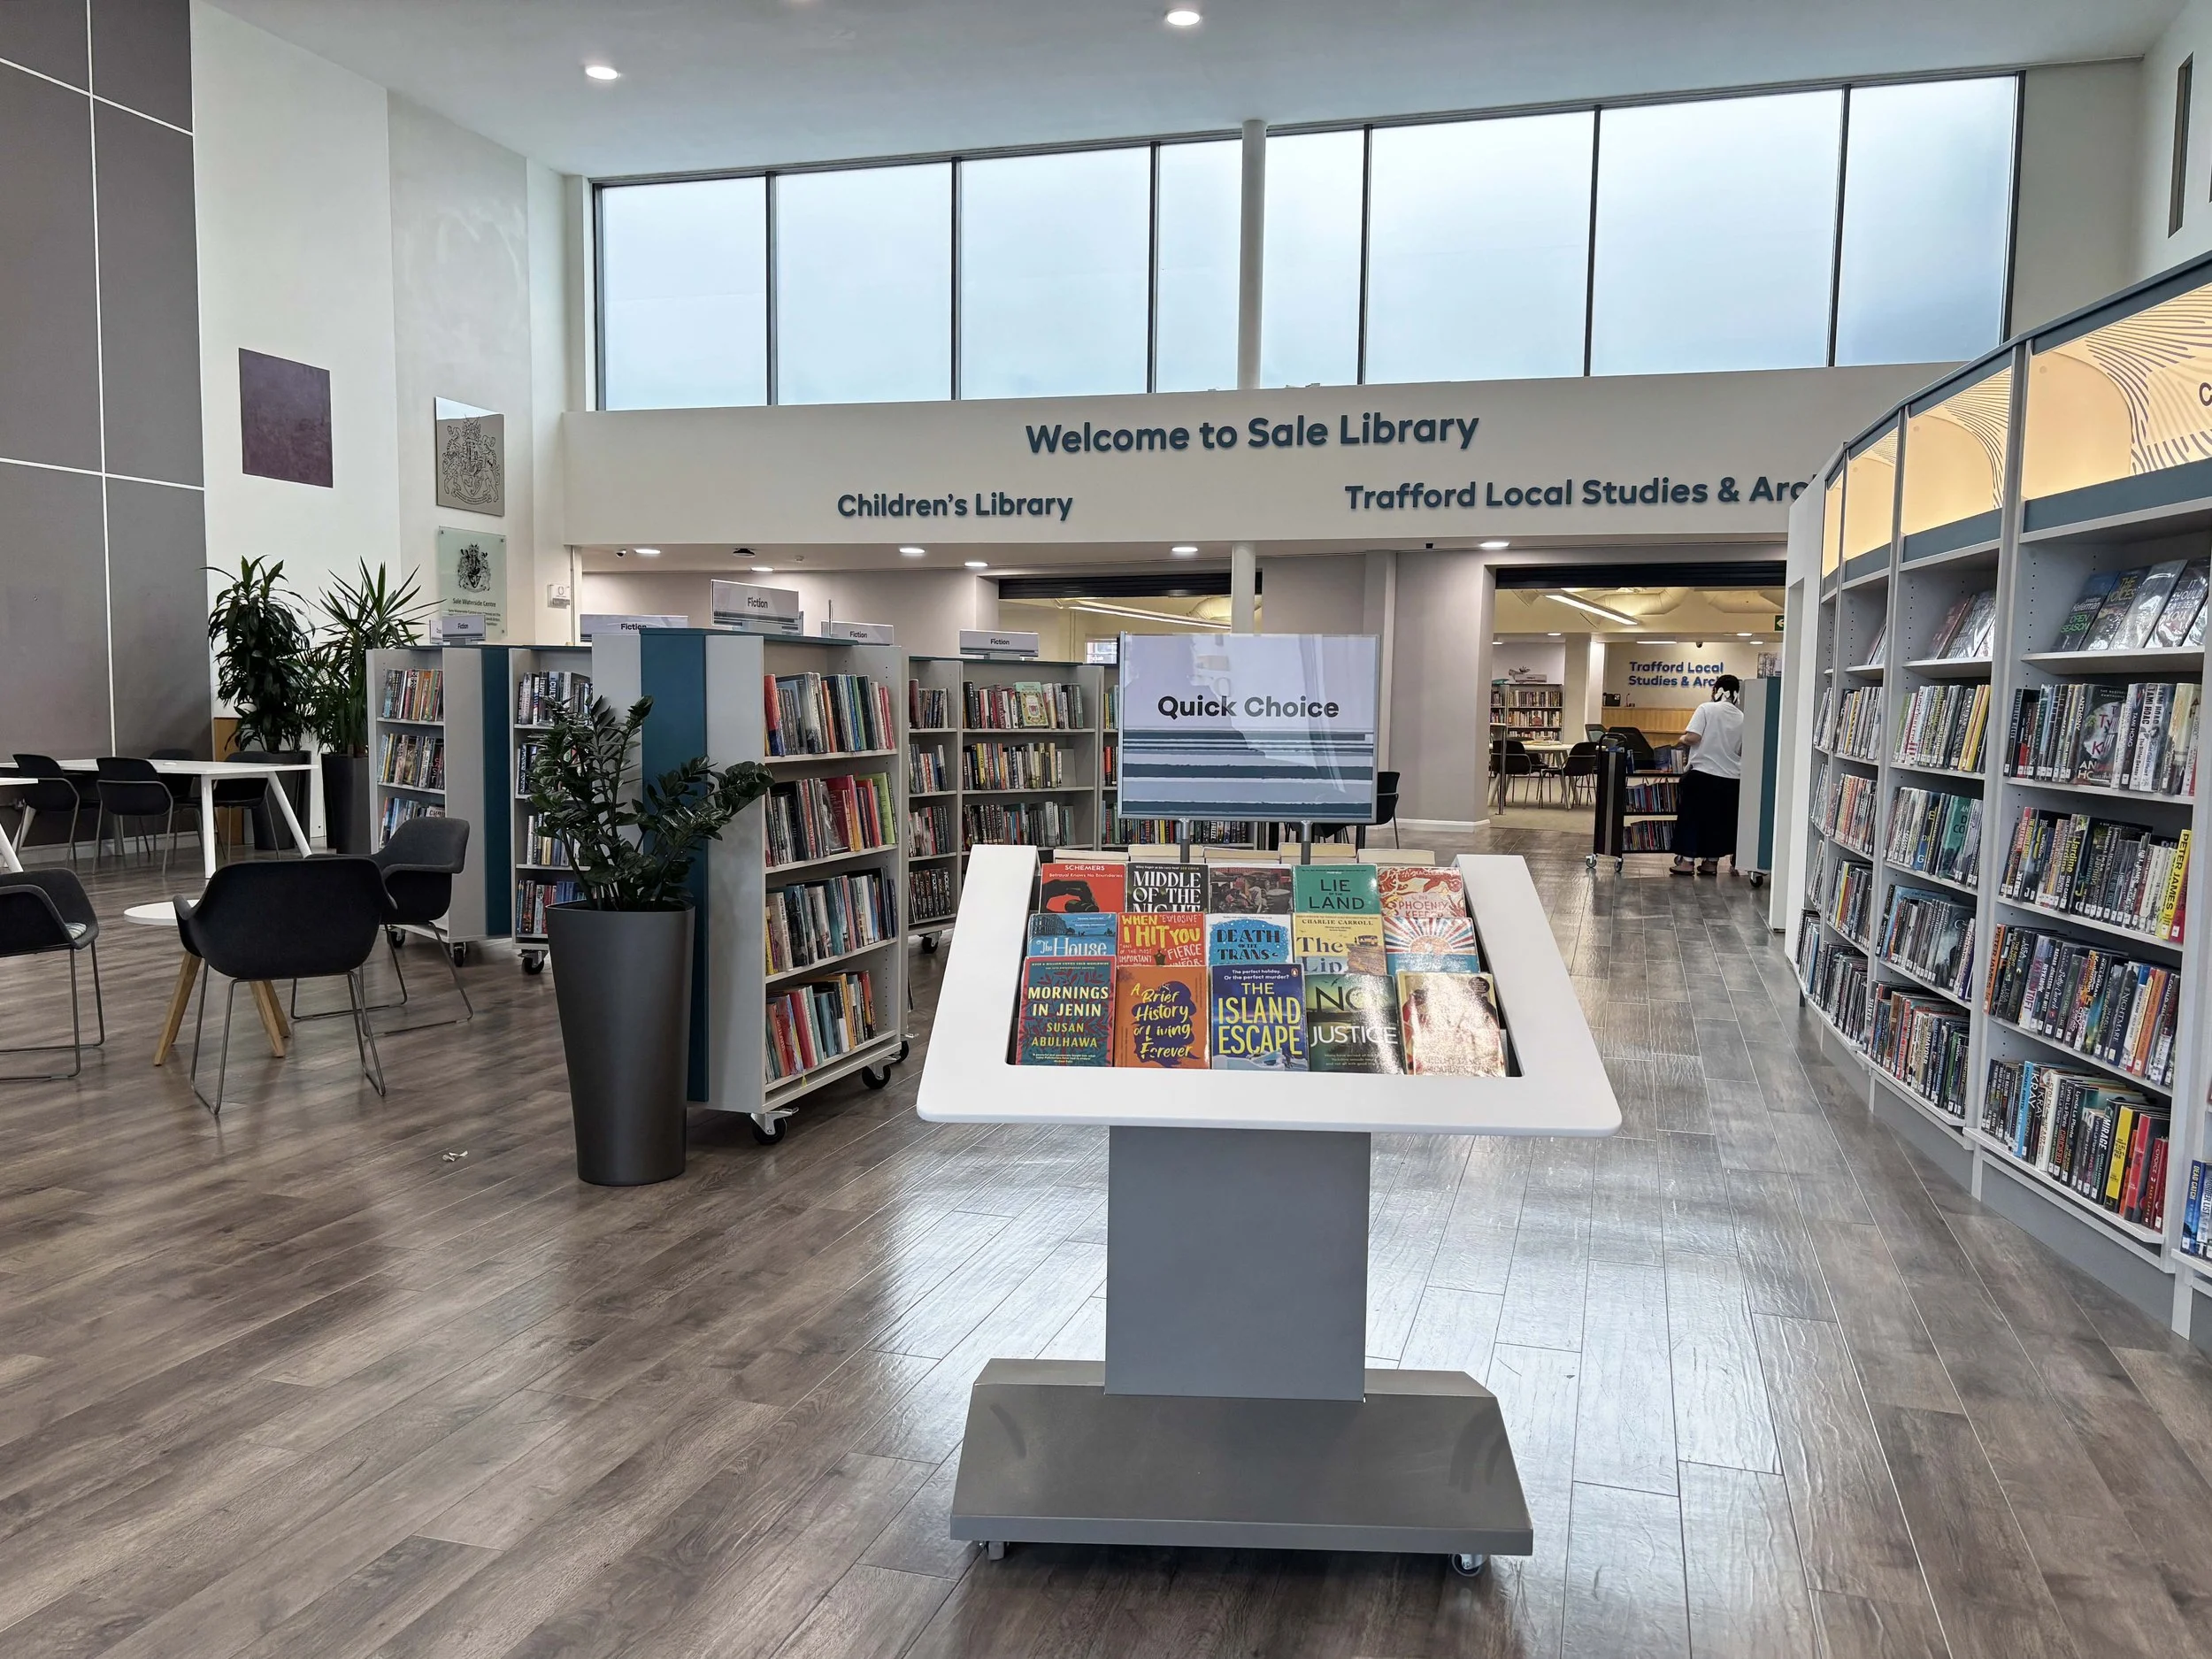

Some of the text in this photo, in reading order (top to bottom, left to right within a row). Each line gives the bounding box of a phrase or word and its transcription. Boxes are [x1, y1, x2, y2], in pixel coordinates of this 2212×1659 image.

[1025, 412, 1479, 454] Welcome to Sale Library
[1345, 473, 1817, 511] Trafford Local Studies & Arc
[837, 492, 1073, 521] Children’s Library
[747, 597, 769, 611] Fiction
[620, 623, 647, 632] Fiction
[849, 630, 868, 640] Fiction
[2061, 623, 2090, 633] SEASON
[990, 638, 1010, 647] Fiction
[1629, 661, 1724, 673] Trafford Local
[1628, 675, 1719, 687] Studies & Arc
[2147, 687, 2155, 704] TAMI
[1157, 695, 1340, 720] Quick Choice
[2076, 696, 2085, 731] ANTHONY
[2067, 836, 2080, 872] Jardine
[1133, 872, 1201, 887] MIDDLE
[2166, 833, 2189, 910] PETER JAMES
[1320, 879, 1350, 892] LIE
[1133, 887, 1201, 903] OF THE
[1310, 896, 1364, 910] LAND
[1399, 901, 1448, 910] PHOENIX
[1122, 915, 1157, 925] WHEN
[1124, 926, 1200, 949] I HIT YOU
[1217, 930, 1279, 942] DEATH
[1036, 937, 1108, 956] The House
[1296, 937, 1343, 953] The
[1302, 956, 1342, 972] Lip
[1986, 926, 2002, 988] PETER JAMES
[2093, 958, 2106, 998] KELLERMAN
[1028, 987, 1109, 999] MORNINGS
[1131, 983, 1141, 995] A
[1141, 989, 1179, 1003] Brief
[1241, 983, 1274, 995] THE
[1033, 1003, 1101, 1017] IN JENIN
[1135, 1004, 1188, 1023] History
[1218, 997, 1301, 1024] ISLAND
[2113, 993, 2130, 1042] NIGHTMARE
[1047, 1023, 1084, 1033] SUSAN
[1032, 1037, 1097, 1047] ABULHAWA
[1218, 1025, 1302, 1055] ESCAPE
[1310, 1026, 1398, 1048] JUSTICE
[1141, 1042, 1193, 1059] Forever
[2028, 1073, 2039, 1110] KRAY
[2034, 1091, 2045, 1121] KRAY
[2072, 1091, 2081, 1110] Lynda
[2099, 1118, 2111, 1149] MIRAGE
[2055, 1129, 2066, 1164] CRUCIFIED
[2202, 1202, 2211, 1216] LIST
